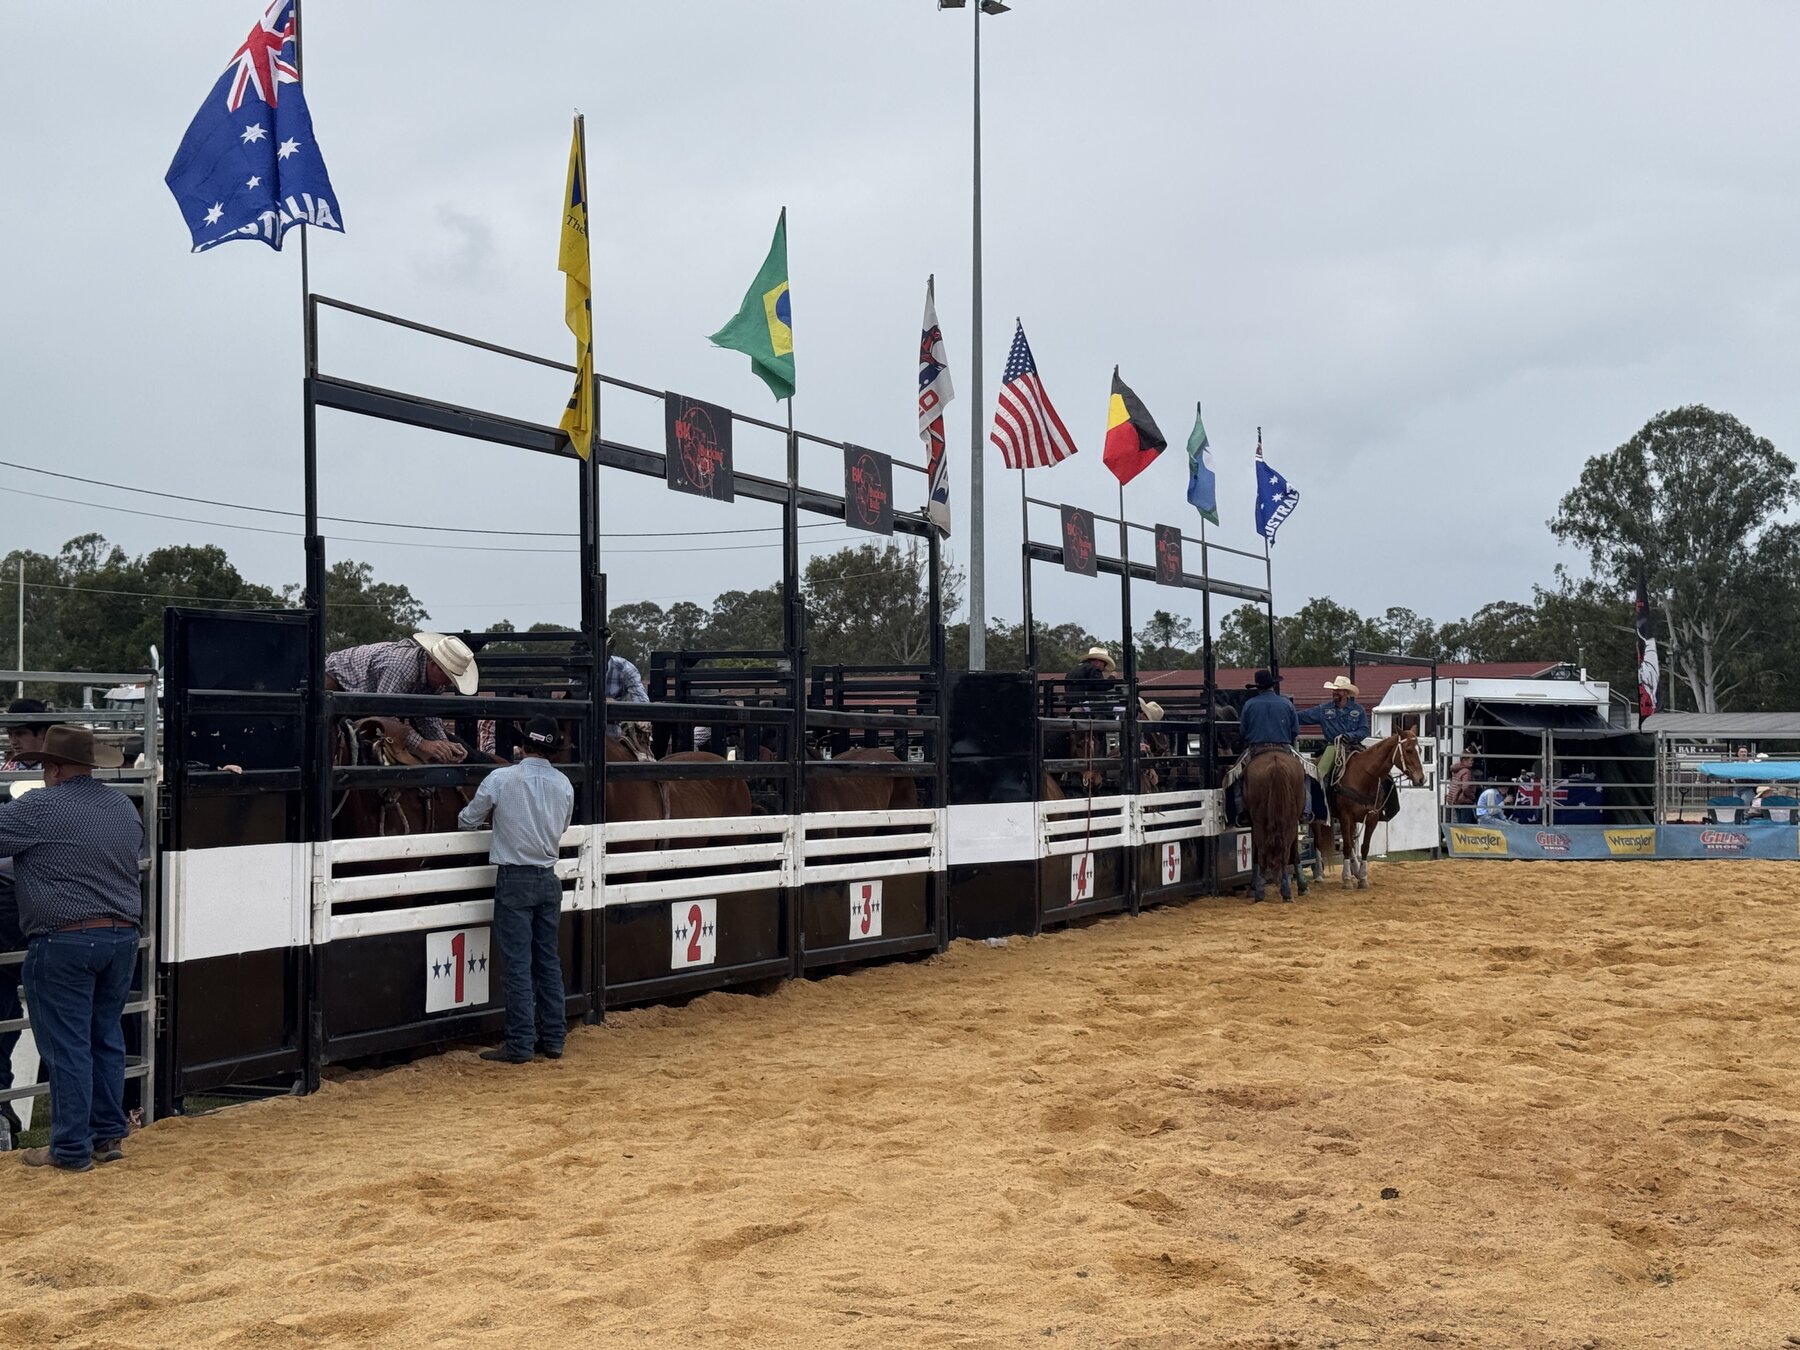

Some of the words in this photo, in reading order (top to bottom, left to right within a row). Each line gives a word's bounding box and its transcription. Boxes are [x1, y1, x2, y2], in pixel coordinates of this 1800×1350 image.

[1241, 835, 1248, 869] 6
[1455, 832, 1502, 850] Wrangler
[1608, 834, 1652, 851] Wrangler
[1168, 845, 1176, 881] 5
[860, 884, 872, 935] 3
[687, 904, 702, 962] 2
[451, 932, 465, 1003] 1
